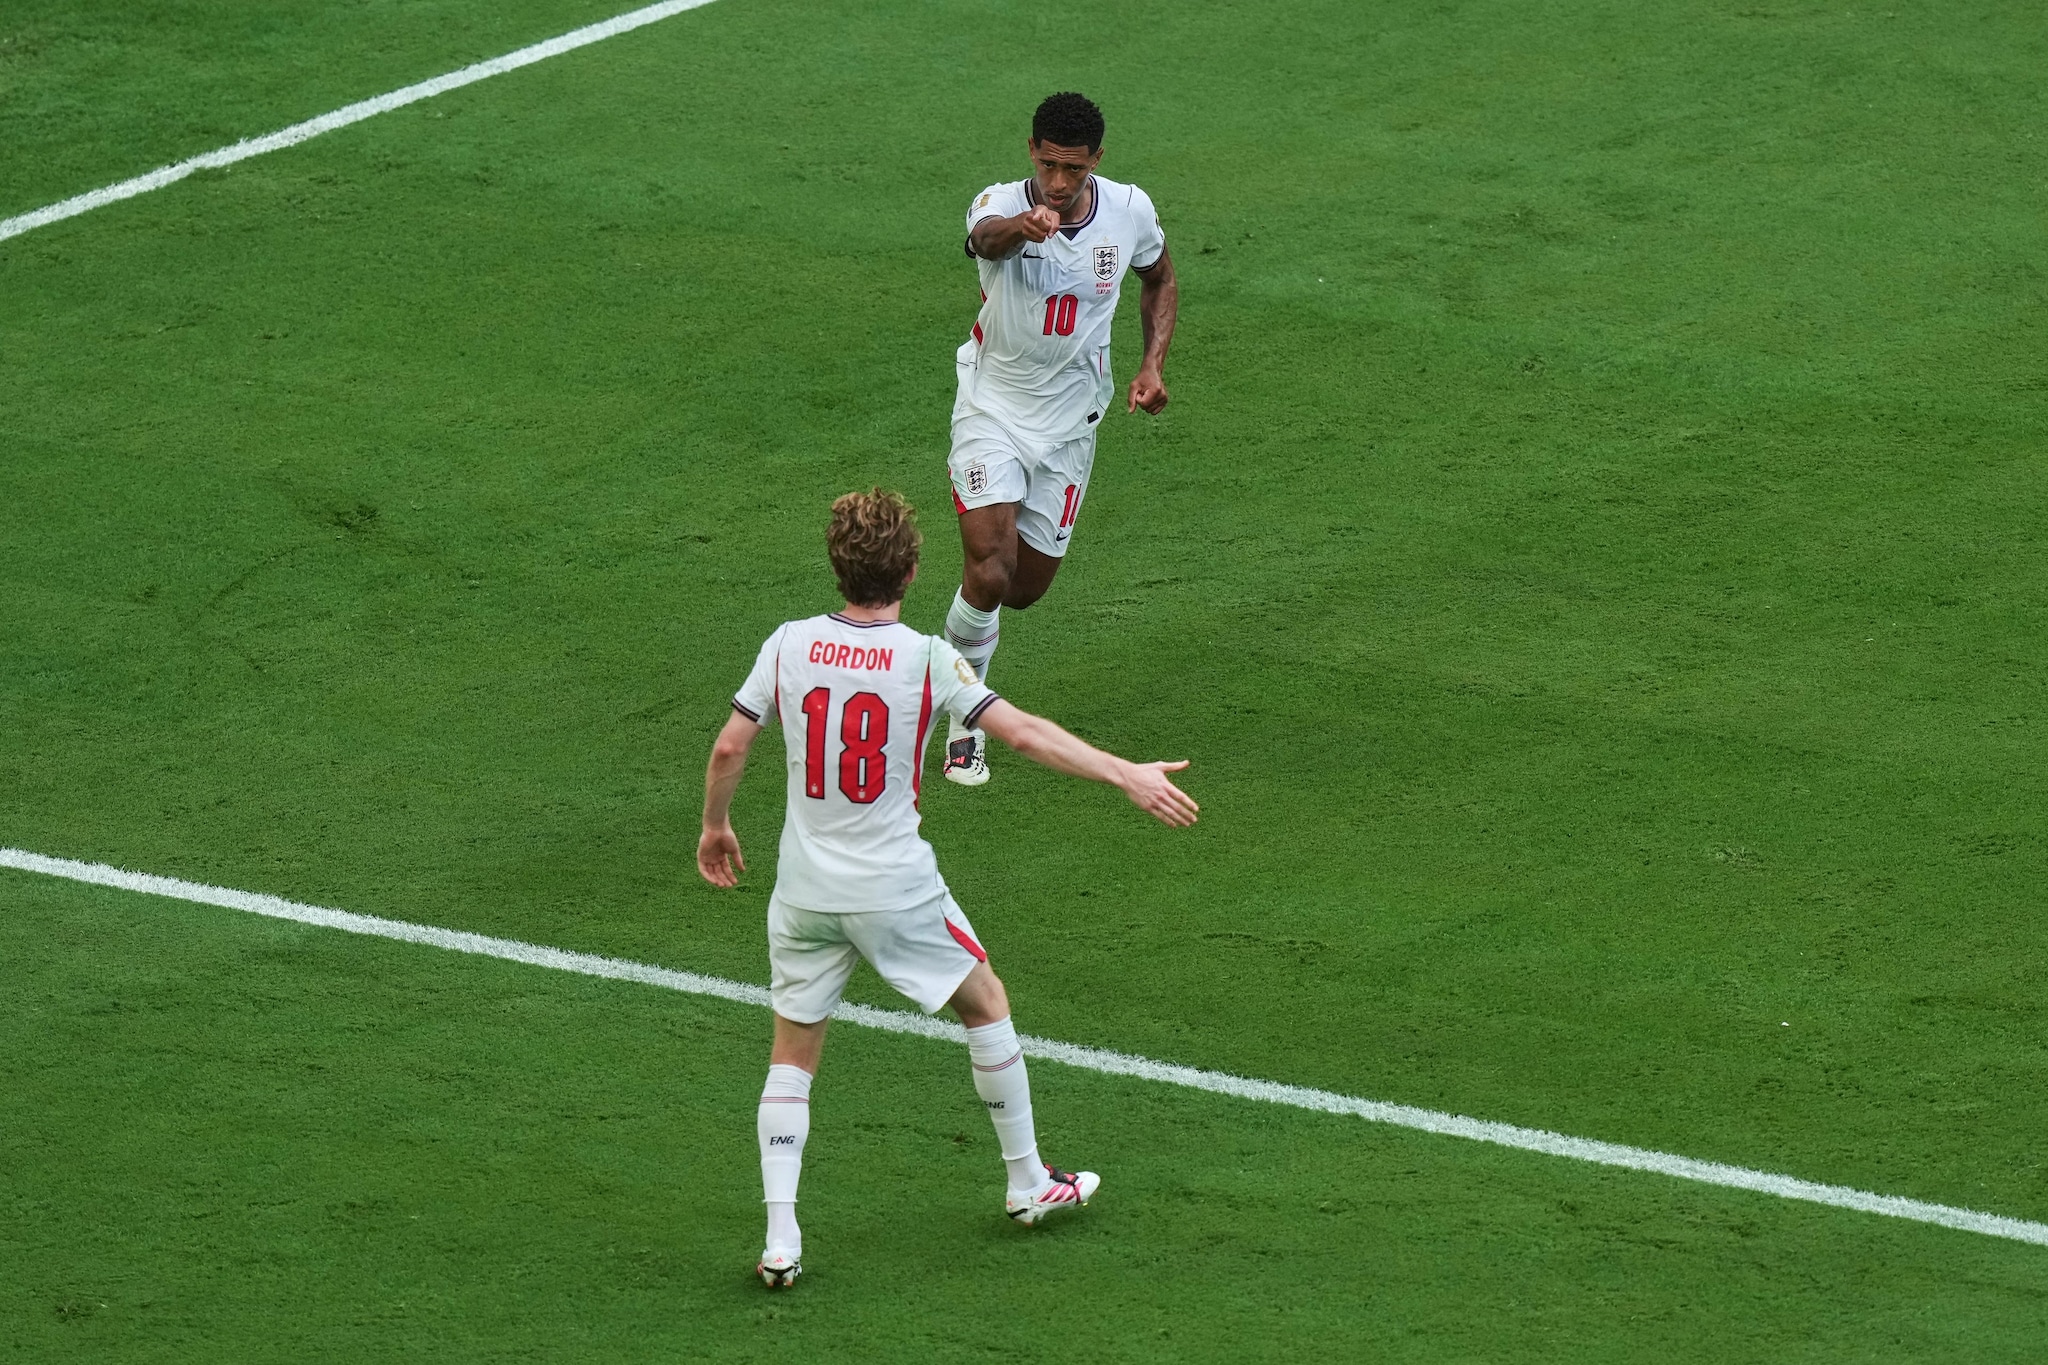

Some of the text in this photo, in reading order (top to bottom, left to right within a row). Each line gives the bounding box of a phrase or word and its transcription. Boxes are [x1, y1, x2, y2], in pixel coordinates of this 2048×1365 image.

[1043, 294, 1079, 337] 10
[809, 640, 893, 671] GORDON
[802, 686, 889, 804] 18
[769, 1135, 796, 1146] ENG
